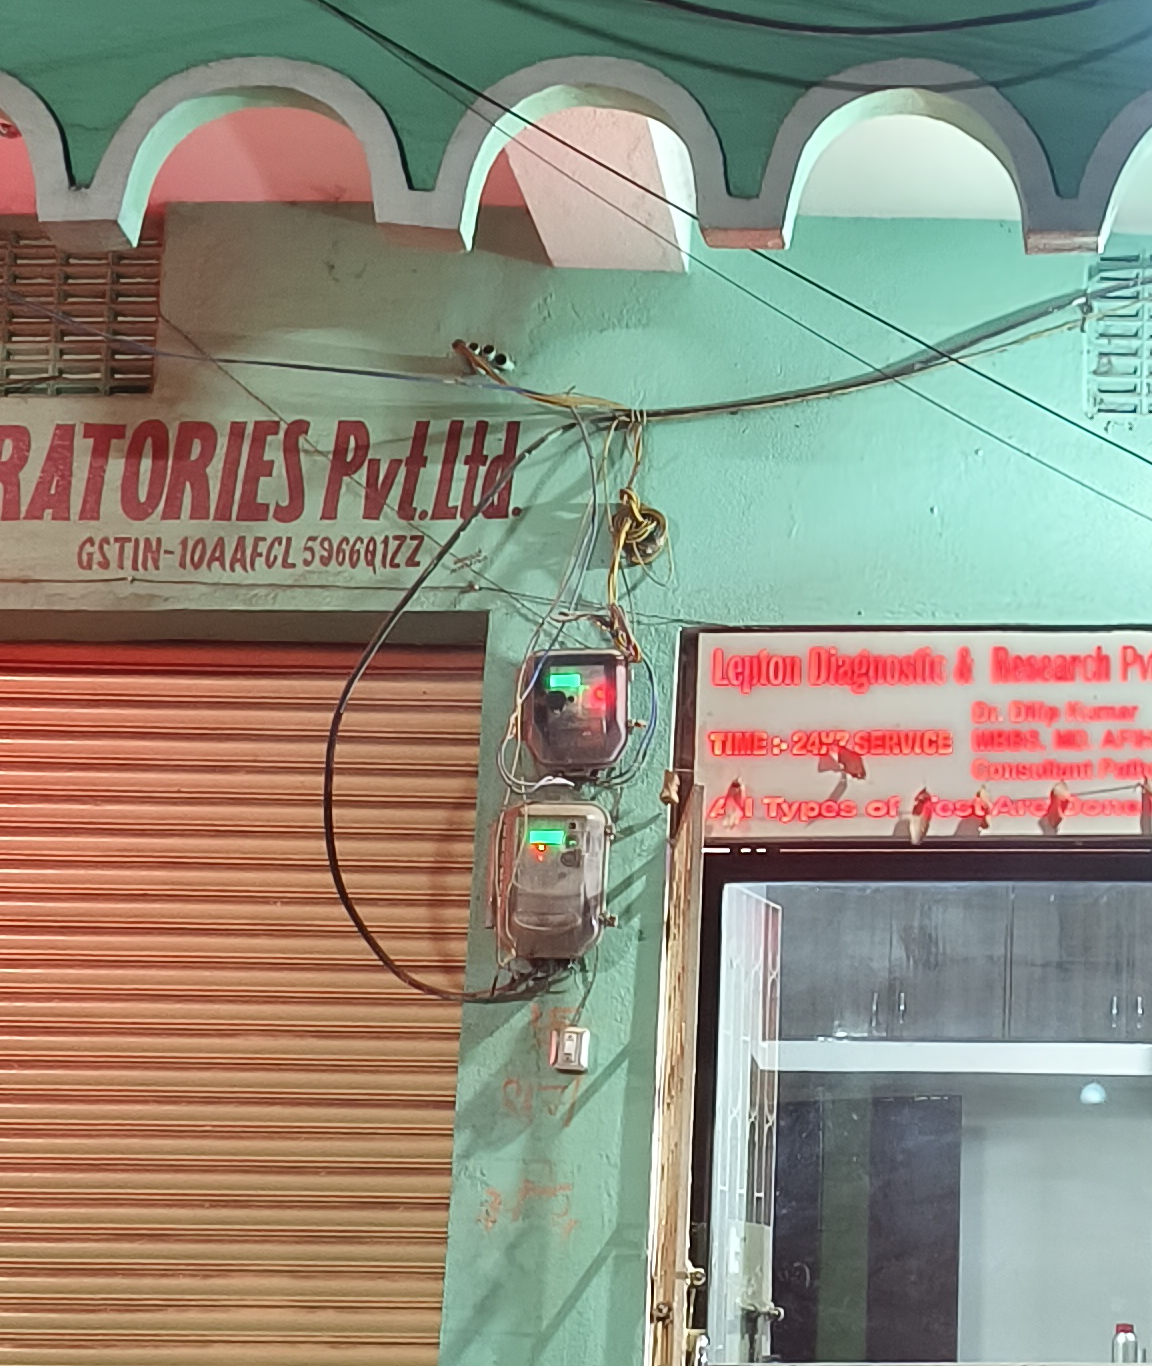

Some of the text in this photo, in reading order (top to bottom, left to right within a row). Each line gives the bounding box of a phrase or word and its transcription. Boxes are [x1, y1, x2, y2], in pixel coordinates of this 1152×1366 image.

[712, 647, 802, 694] Lepton
[807, 646, 948, 694] Diagnostic
[953, 646, 974, 684] &
[990, 646, 1111, 684] Research
[708, 732, 768, 756] TIME
[853, 730, 954, 756] SERVICE
[762, 795, 858, 823] Types
[864, 794, 902, 819] of
[914, 795, 989, 819] est
